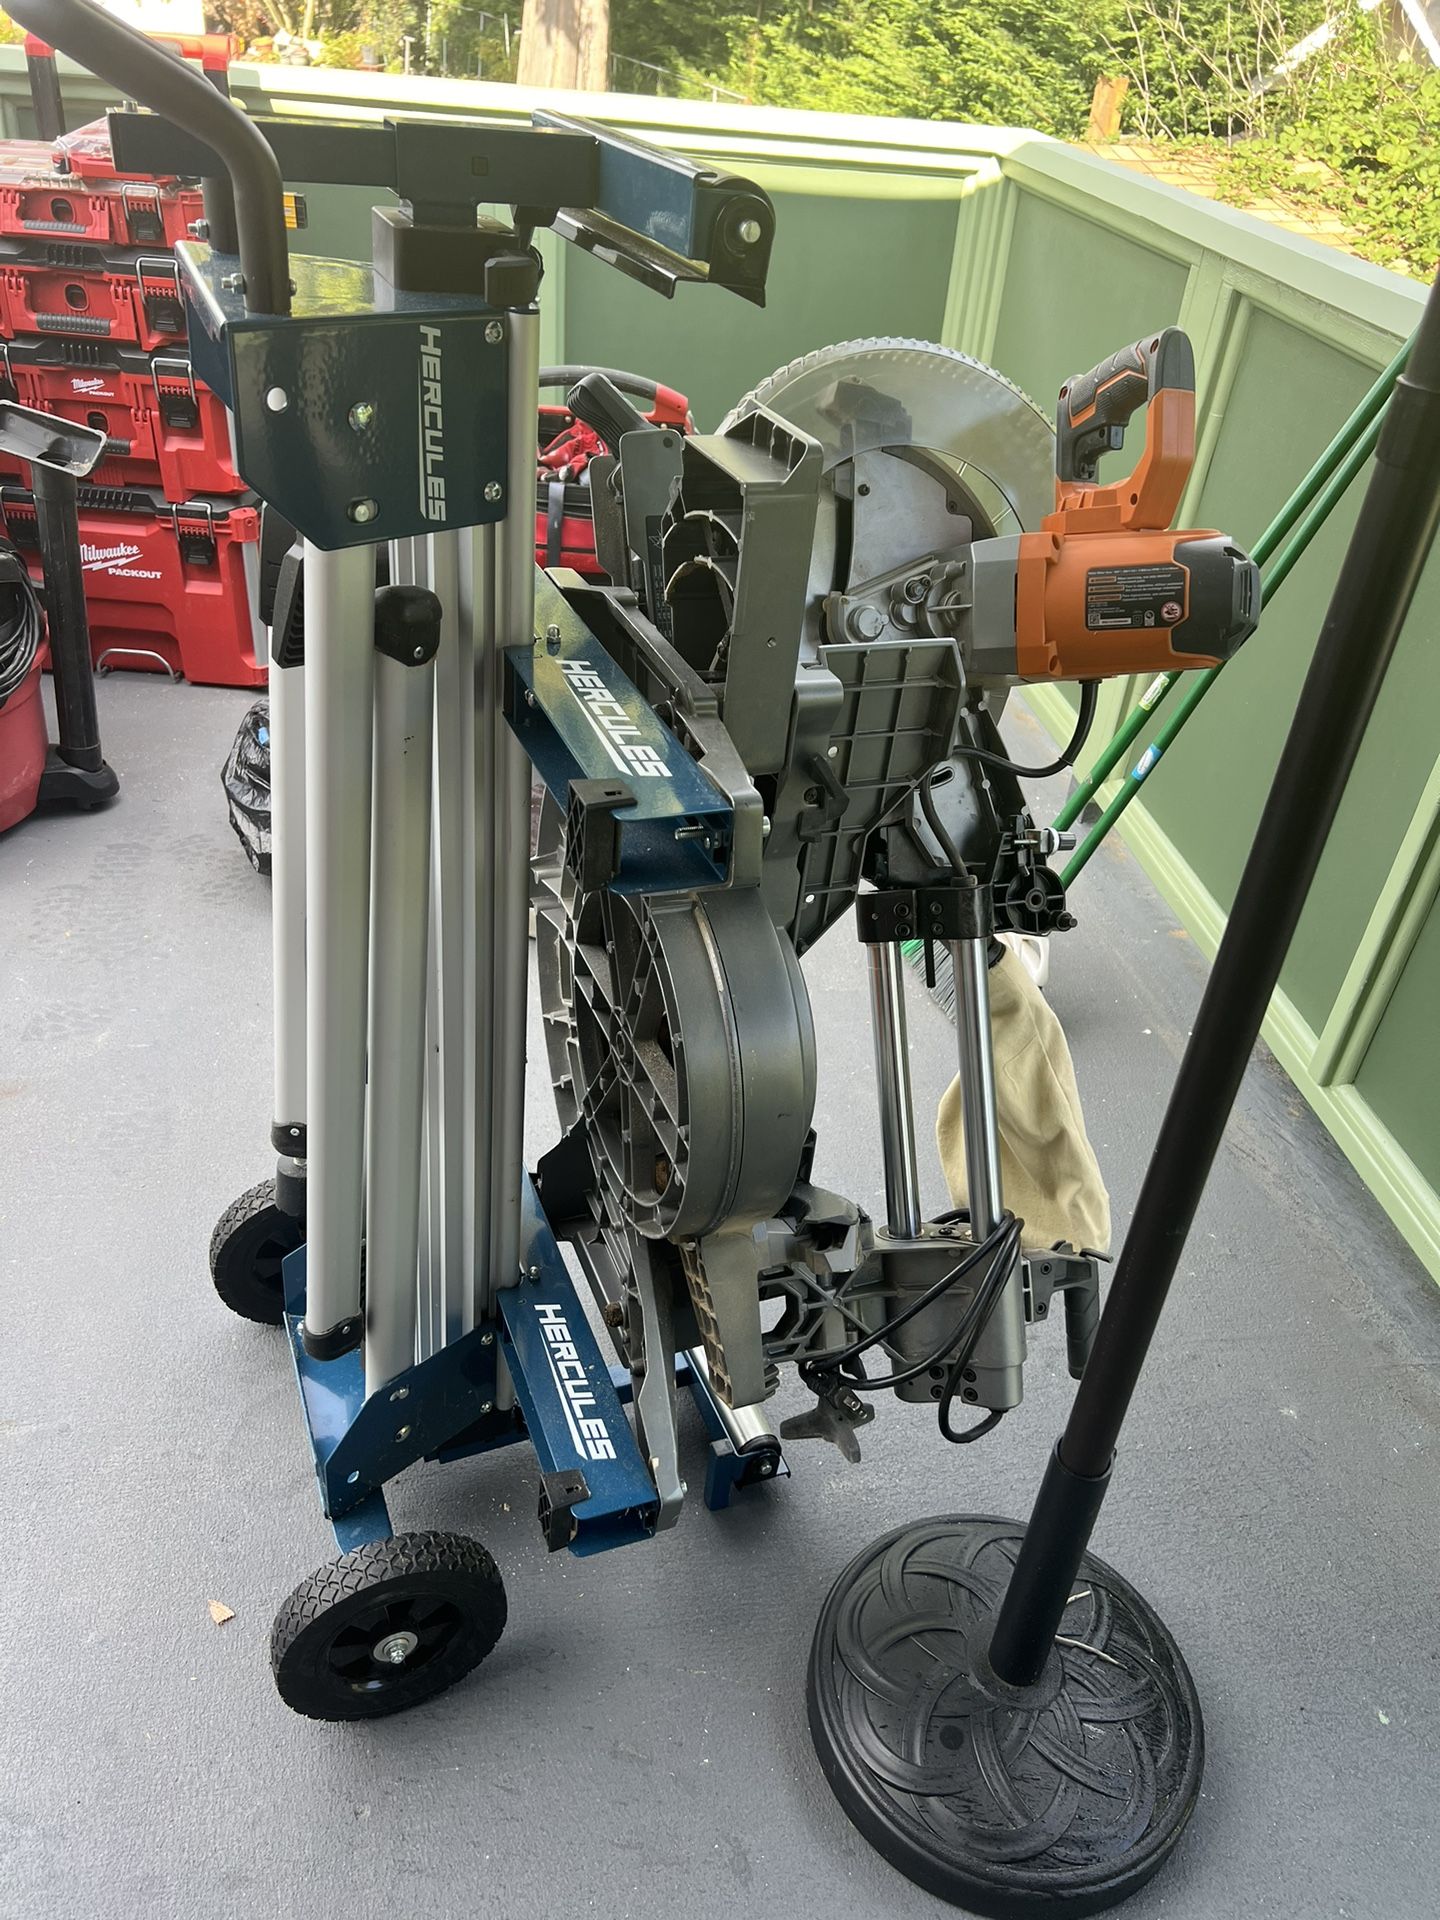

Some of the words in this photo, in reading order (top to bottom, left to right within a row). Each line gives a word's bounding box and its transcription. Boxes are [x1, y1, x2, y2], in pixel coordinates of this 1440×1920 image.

[420, 325, 446, 521] HERCULES
[108, 567, 162, 579] PACKOUT
[555, 660, 673, 777] HERCULES
[534, 1304, 617, 1460] HERCULES
